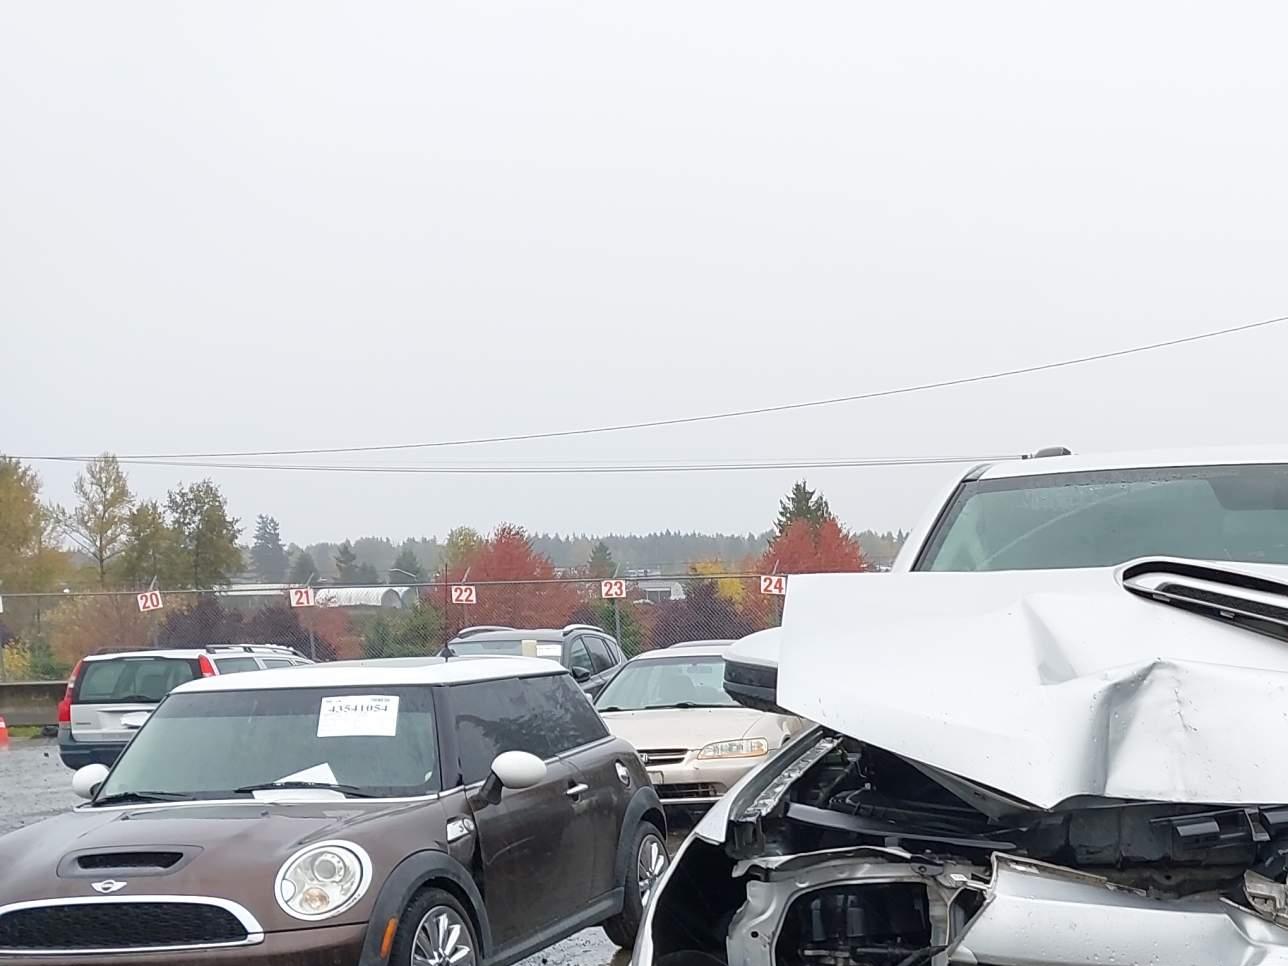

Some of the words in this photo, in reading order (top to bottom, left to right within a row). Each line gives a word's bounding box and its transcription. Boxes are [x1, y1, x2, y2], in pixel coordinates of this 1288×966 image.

[603, 581, 624, 597] 23
[763, 577, 784, 593] 24
[140, 592, 160, 609] 20
[294, 590, 310, 605] 21
[454, 587, 474, 602] 22
